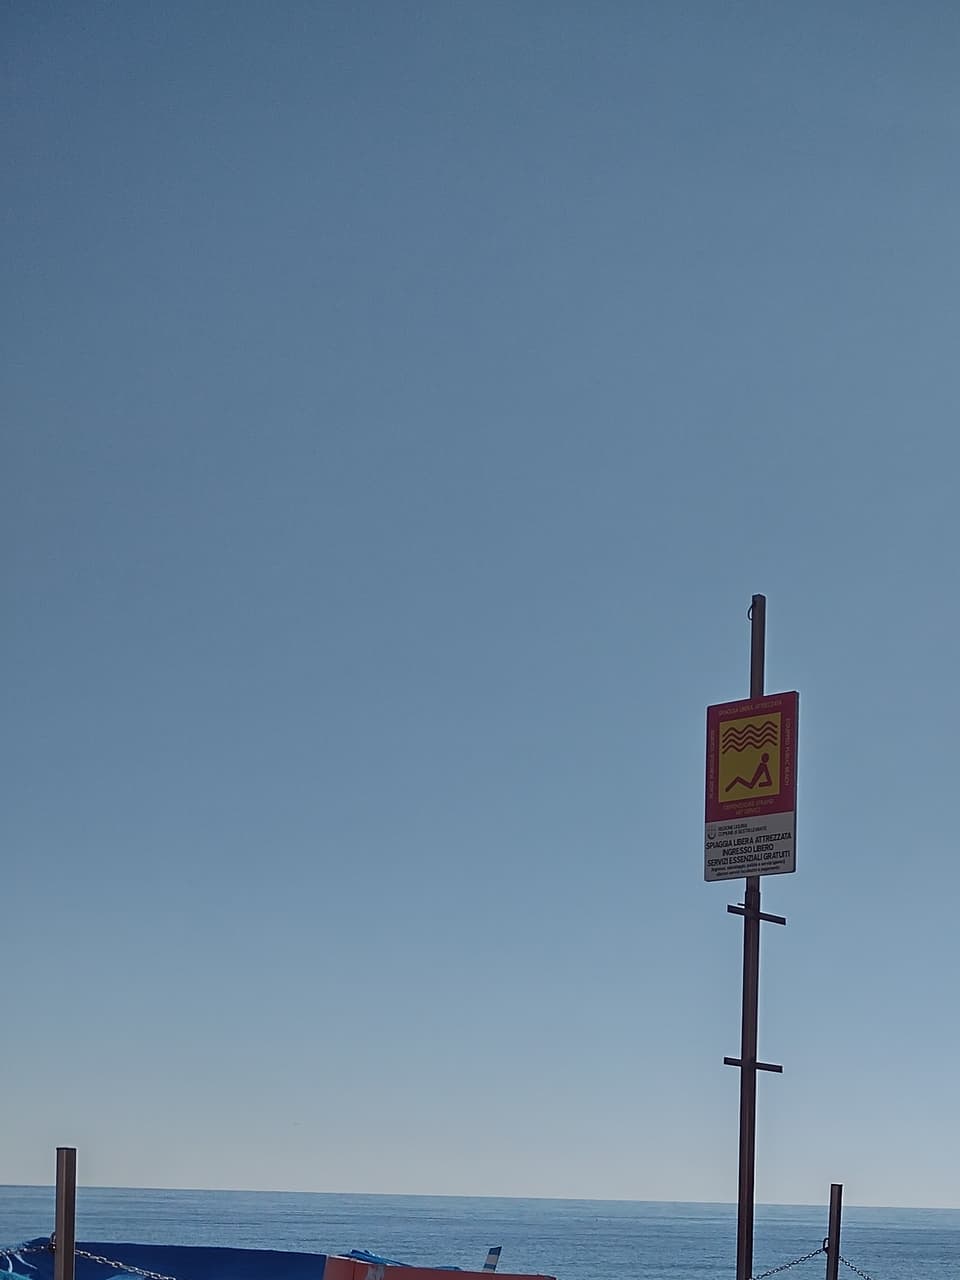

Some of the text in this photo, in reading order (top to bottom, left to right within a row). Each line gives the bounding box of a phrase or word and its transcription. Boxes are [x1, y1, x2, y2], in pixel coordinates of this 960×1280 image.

[705, 832, 792, 849] SPIAGGIA LIBERA ATTREZZATA
[707, 858, 728, 867] SERVIZI
[729, 854, 762, 864] ESSENZIALI
[763, 850, 790, 860] GRATUITI
[722, 844, 774, 856] INGRESSO LIBERO
